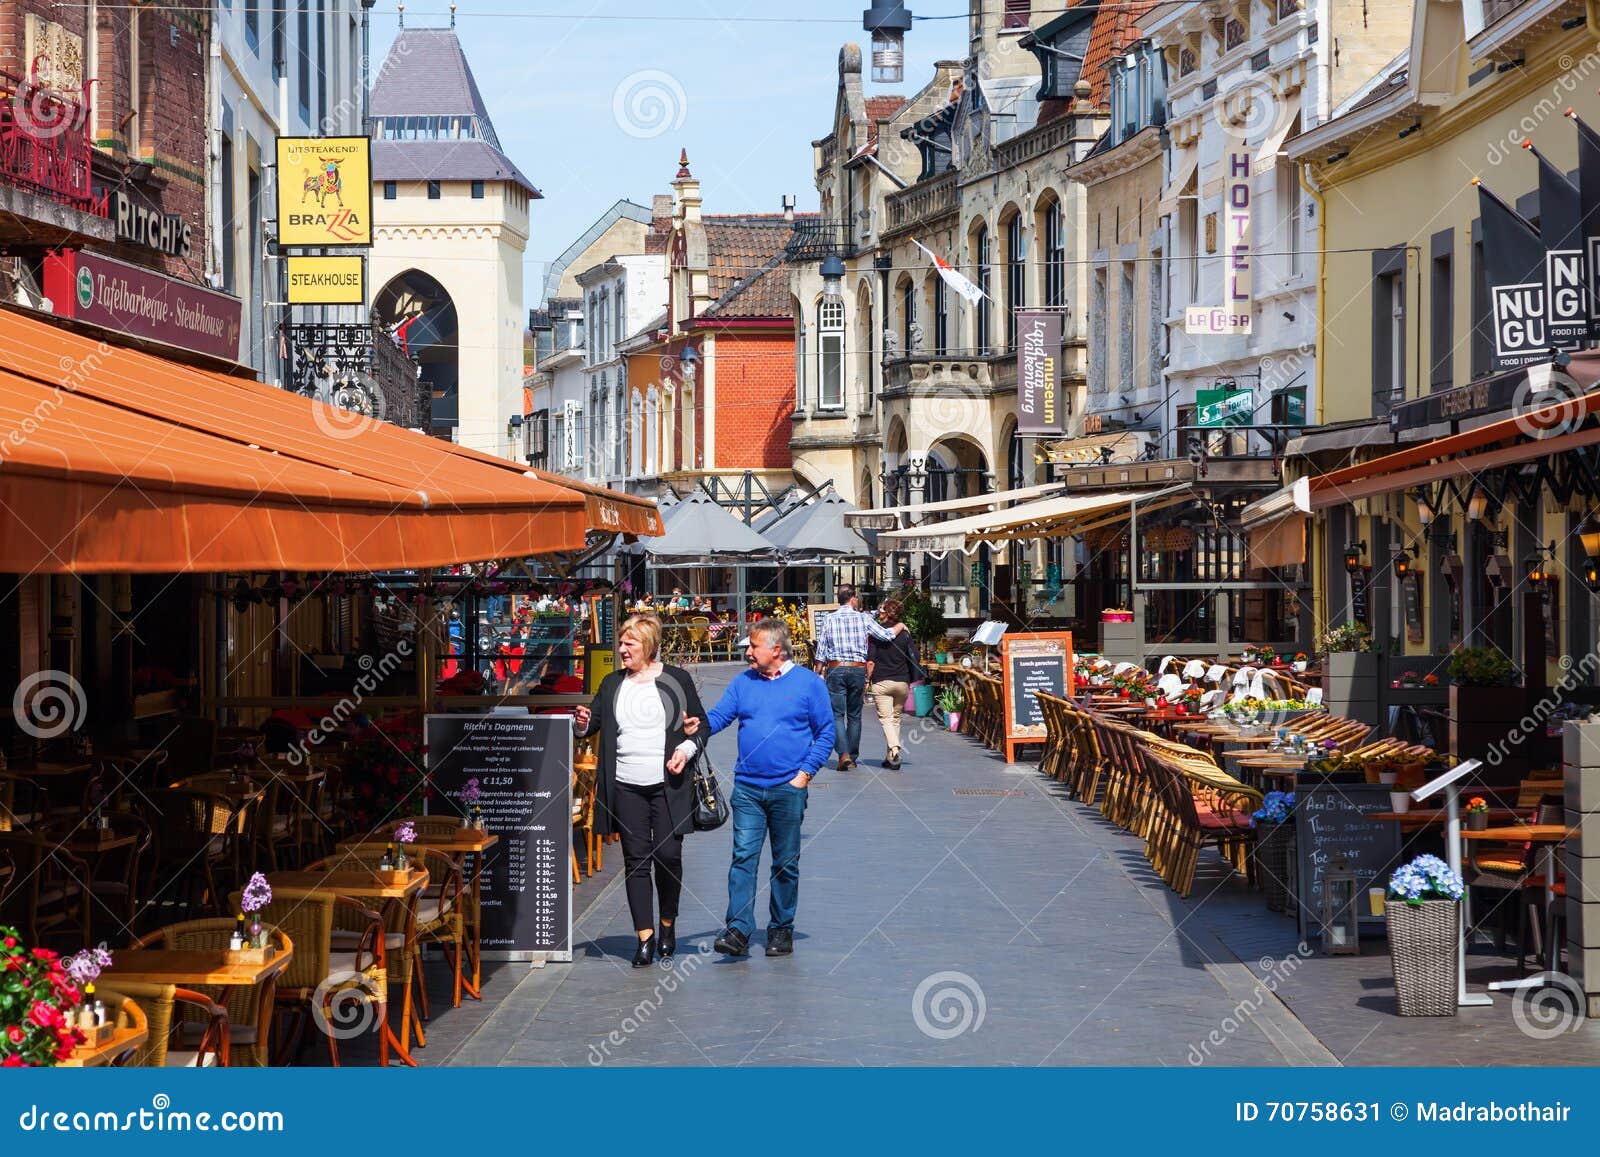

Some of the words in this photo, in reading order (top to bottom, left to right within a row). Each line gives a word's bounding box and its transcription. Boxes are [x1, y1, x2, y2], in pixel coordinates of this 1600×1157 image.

[117, 190, 192, 258] RITCHI'S
[288, 209, 364, 242] BRAZZA
[1231, 153, 1249, 300] HOTEL
[291, 275, 359, 287] STEAKHOUSE
[1554, 257, 1584, 287] N
[97, 273, 169, 326] Tafelbarbeque
[175, 297, 225, 338] Steakhouse
[1499, 289, 1544, 320] NU
[1555, 288, 1587, 317] G
[1189, 315, 1206, 326] LA
[1501, 319, 1545, 348] GU
[1034, 320, 1047, 357] Land
[1021, 332, 1036, 414] Valkenburg
[1034, 361, 1044, 388] van
[1044, 357, 1055, 424] museum
[463, 723, 493, 731] Ritchi's
[491, 777, 513, 785] 11,50
